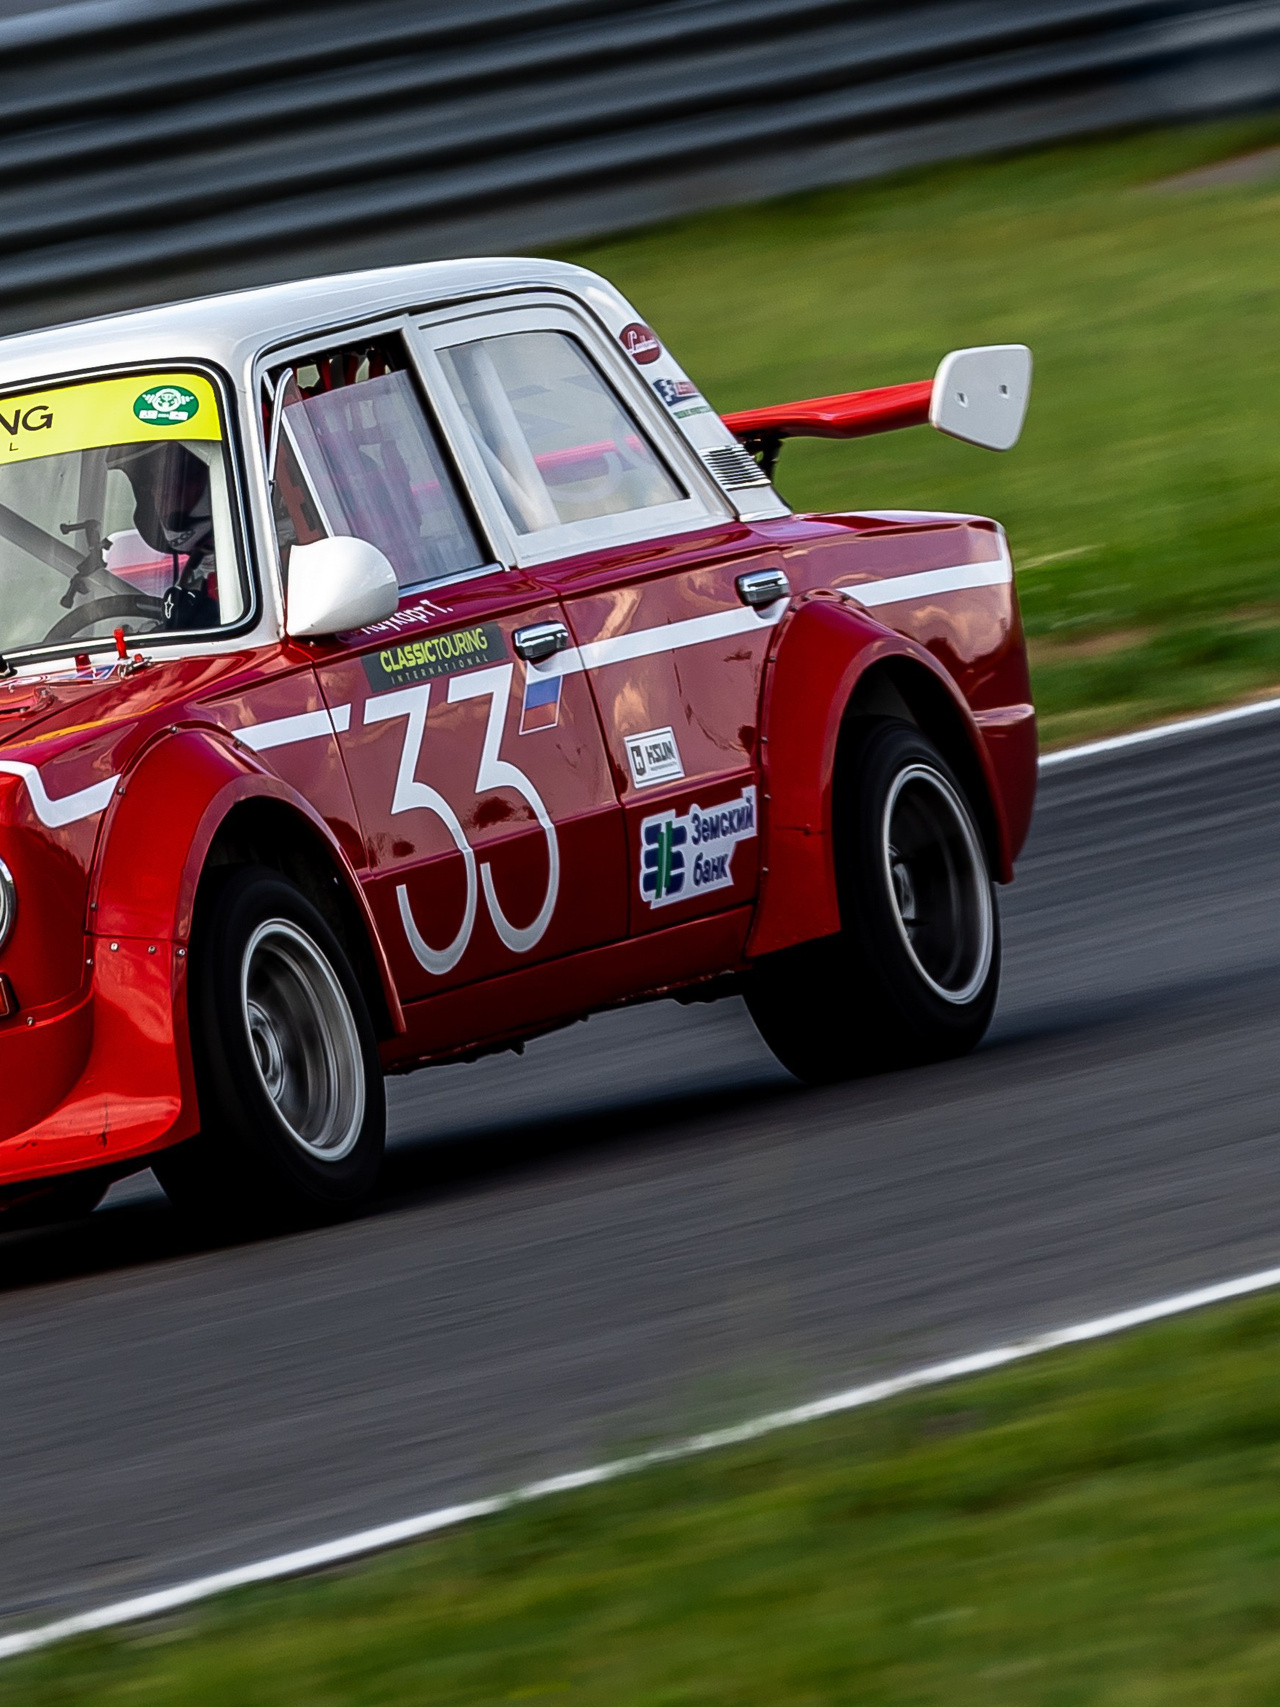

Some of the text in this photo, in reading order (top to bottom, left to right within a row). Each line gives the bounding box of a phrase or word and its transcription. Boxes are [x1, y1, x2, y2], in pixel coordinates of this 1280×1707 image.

[390, 653, 489, 685] INTERNATIONAL
[363, 662, 560, 975] 33
[691, 796, 755, 846] Земский
[693, 852, 729, 887] банк
